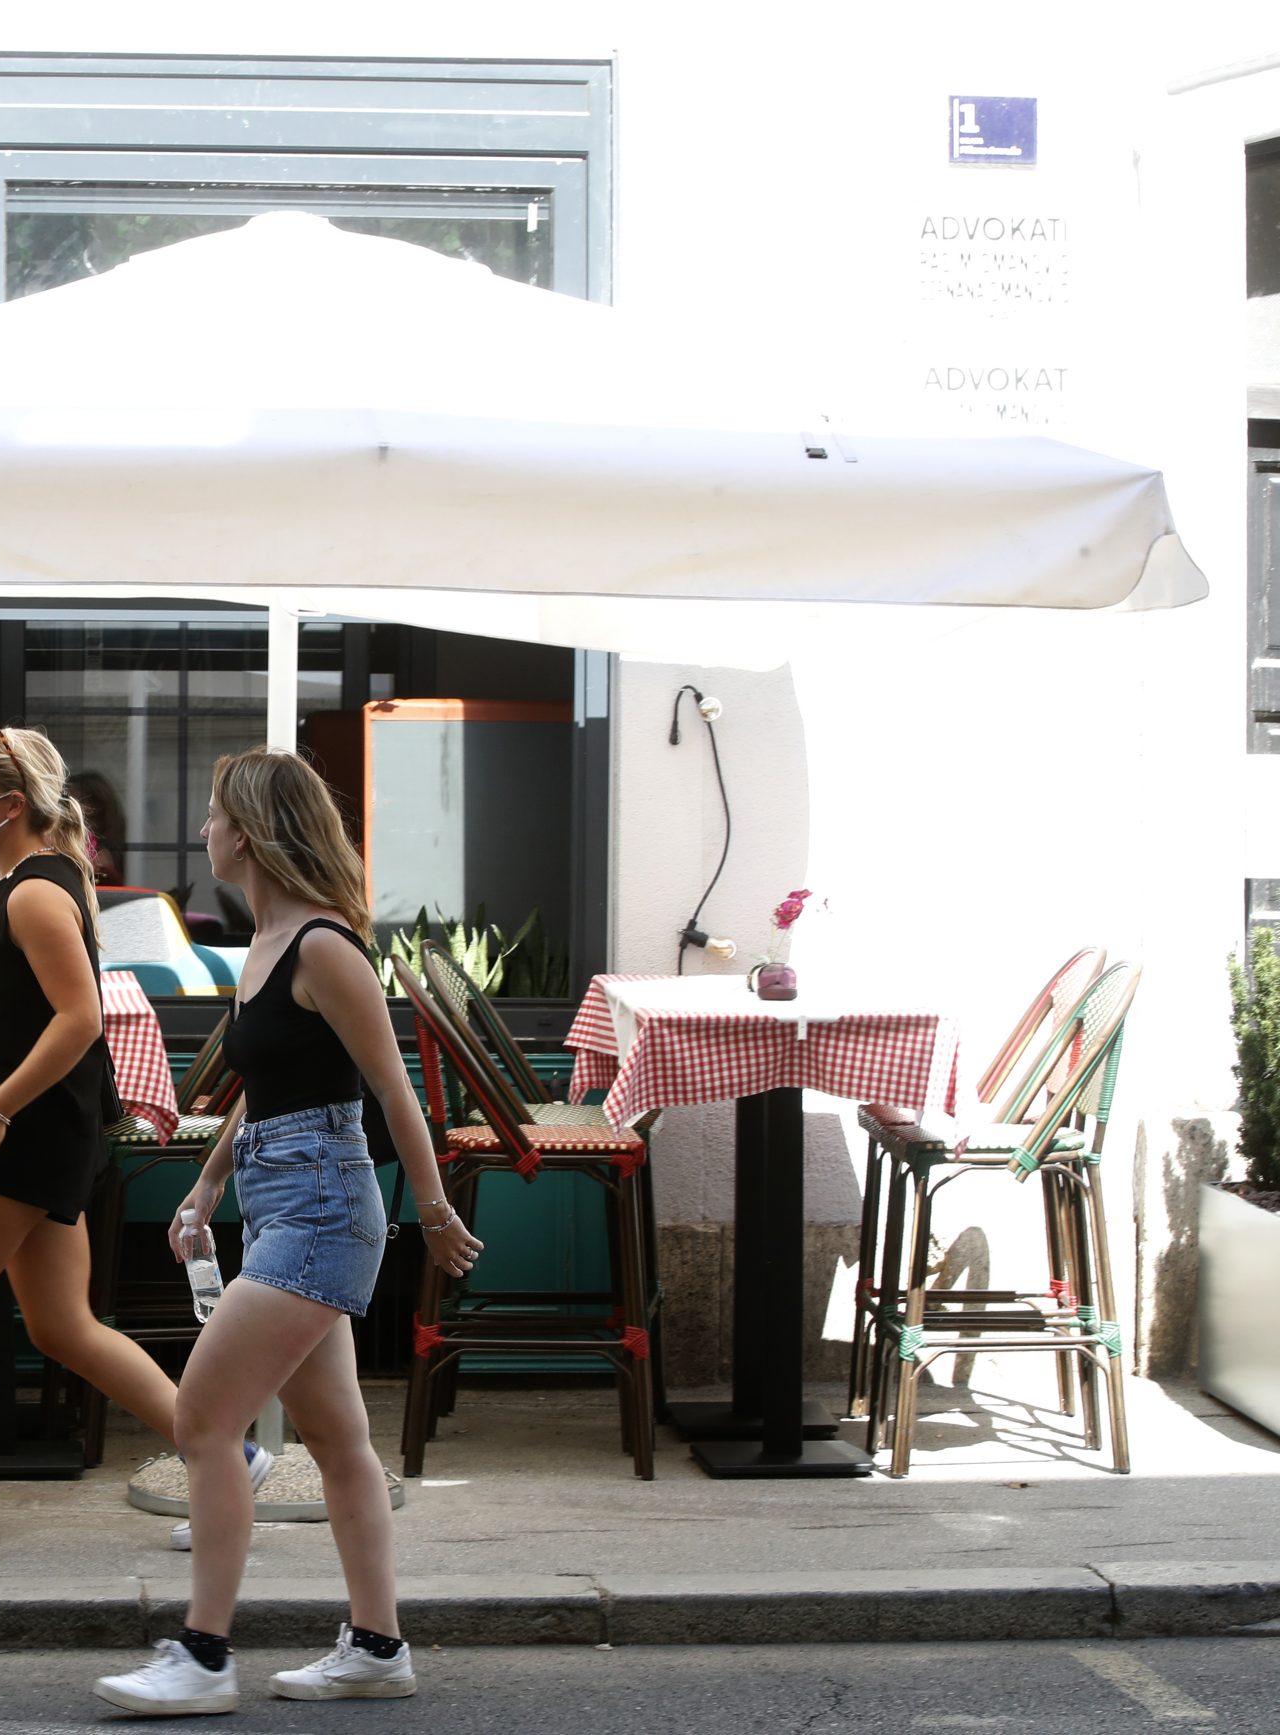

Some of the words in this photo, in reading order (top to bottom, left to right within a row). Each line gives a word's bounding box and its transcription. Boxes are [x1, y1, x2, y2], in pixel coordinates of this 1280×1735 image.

[959, 103, 980, 133] 1
[920, 216, 1068, 241] ADVOKATI
[923, 367, 1069, 392] ADVOKAT
